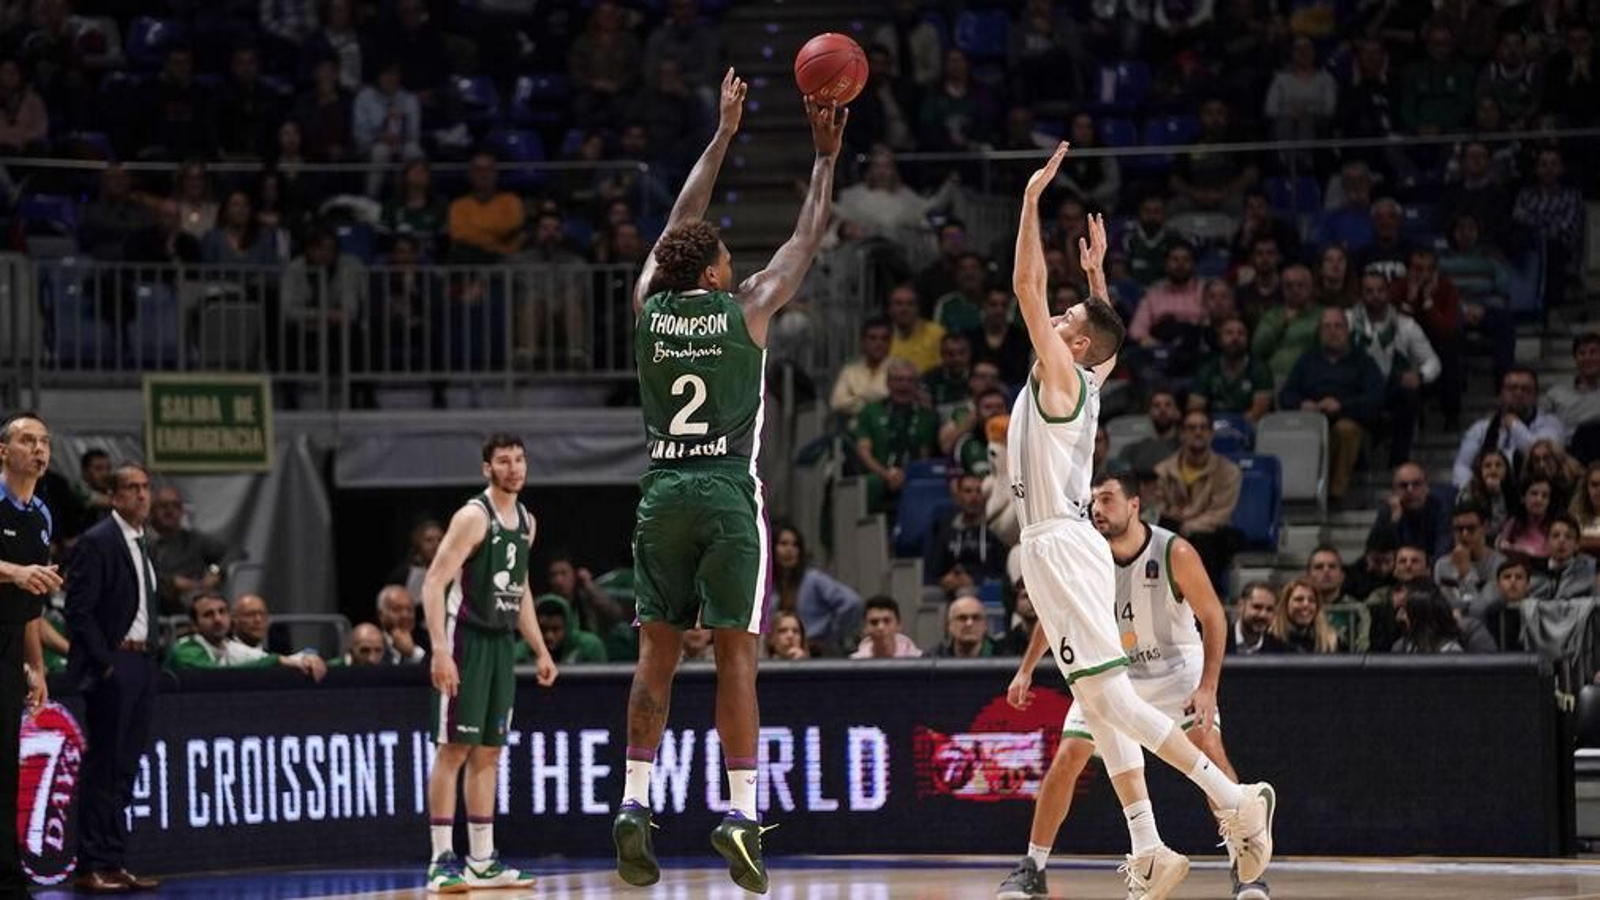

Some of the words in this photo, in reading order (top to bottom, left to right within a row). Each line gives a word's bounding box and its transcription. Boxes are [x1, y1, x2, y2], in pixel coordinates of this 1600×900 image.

[650, 312, 728, 336] THOMPSON
[160, 394, 222, 423] SALIDA
[233, 394, 255, 423] DE
[669, 374, 709, 435] 2
[156, 427, 263, 455] EMERGENCIA
[1059, 637, 1075, 664] 6
[19, 729, 66, 856] 7
[45, 742, 81, 851] DAYS
[187, 731, 399, 828] CROISSANT
[497, 729, 610, 815] THE
